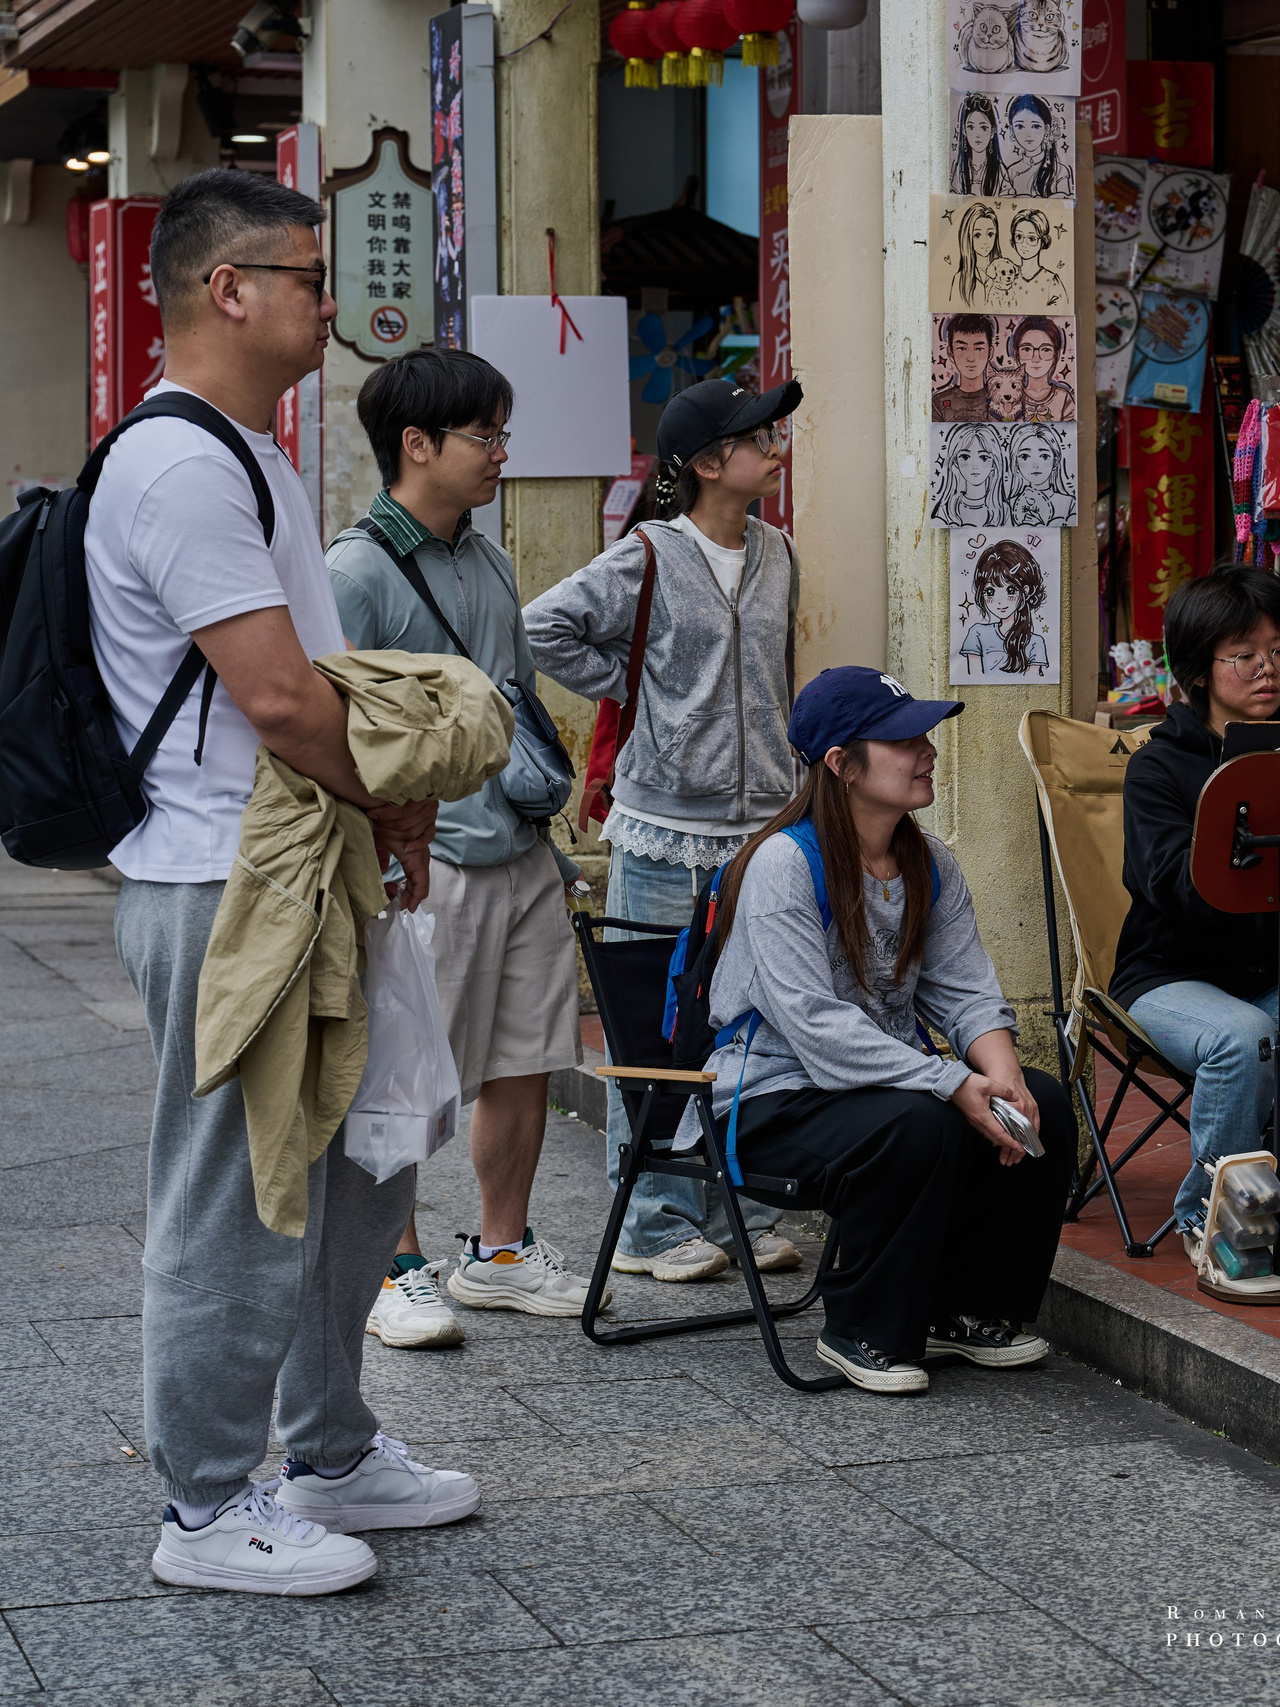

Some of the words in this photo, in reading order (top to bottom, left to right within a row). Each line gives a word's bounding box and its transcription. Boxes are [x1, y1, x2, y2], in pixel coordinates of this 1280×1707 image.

[366, 191, 388, 300] 文明你我他
[391, 191, 412, 300] 禁鸣靠大家
[248, 1537, 273, 1554] FILA
